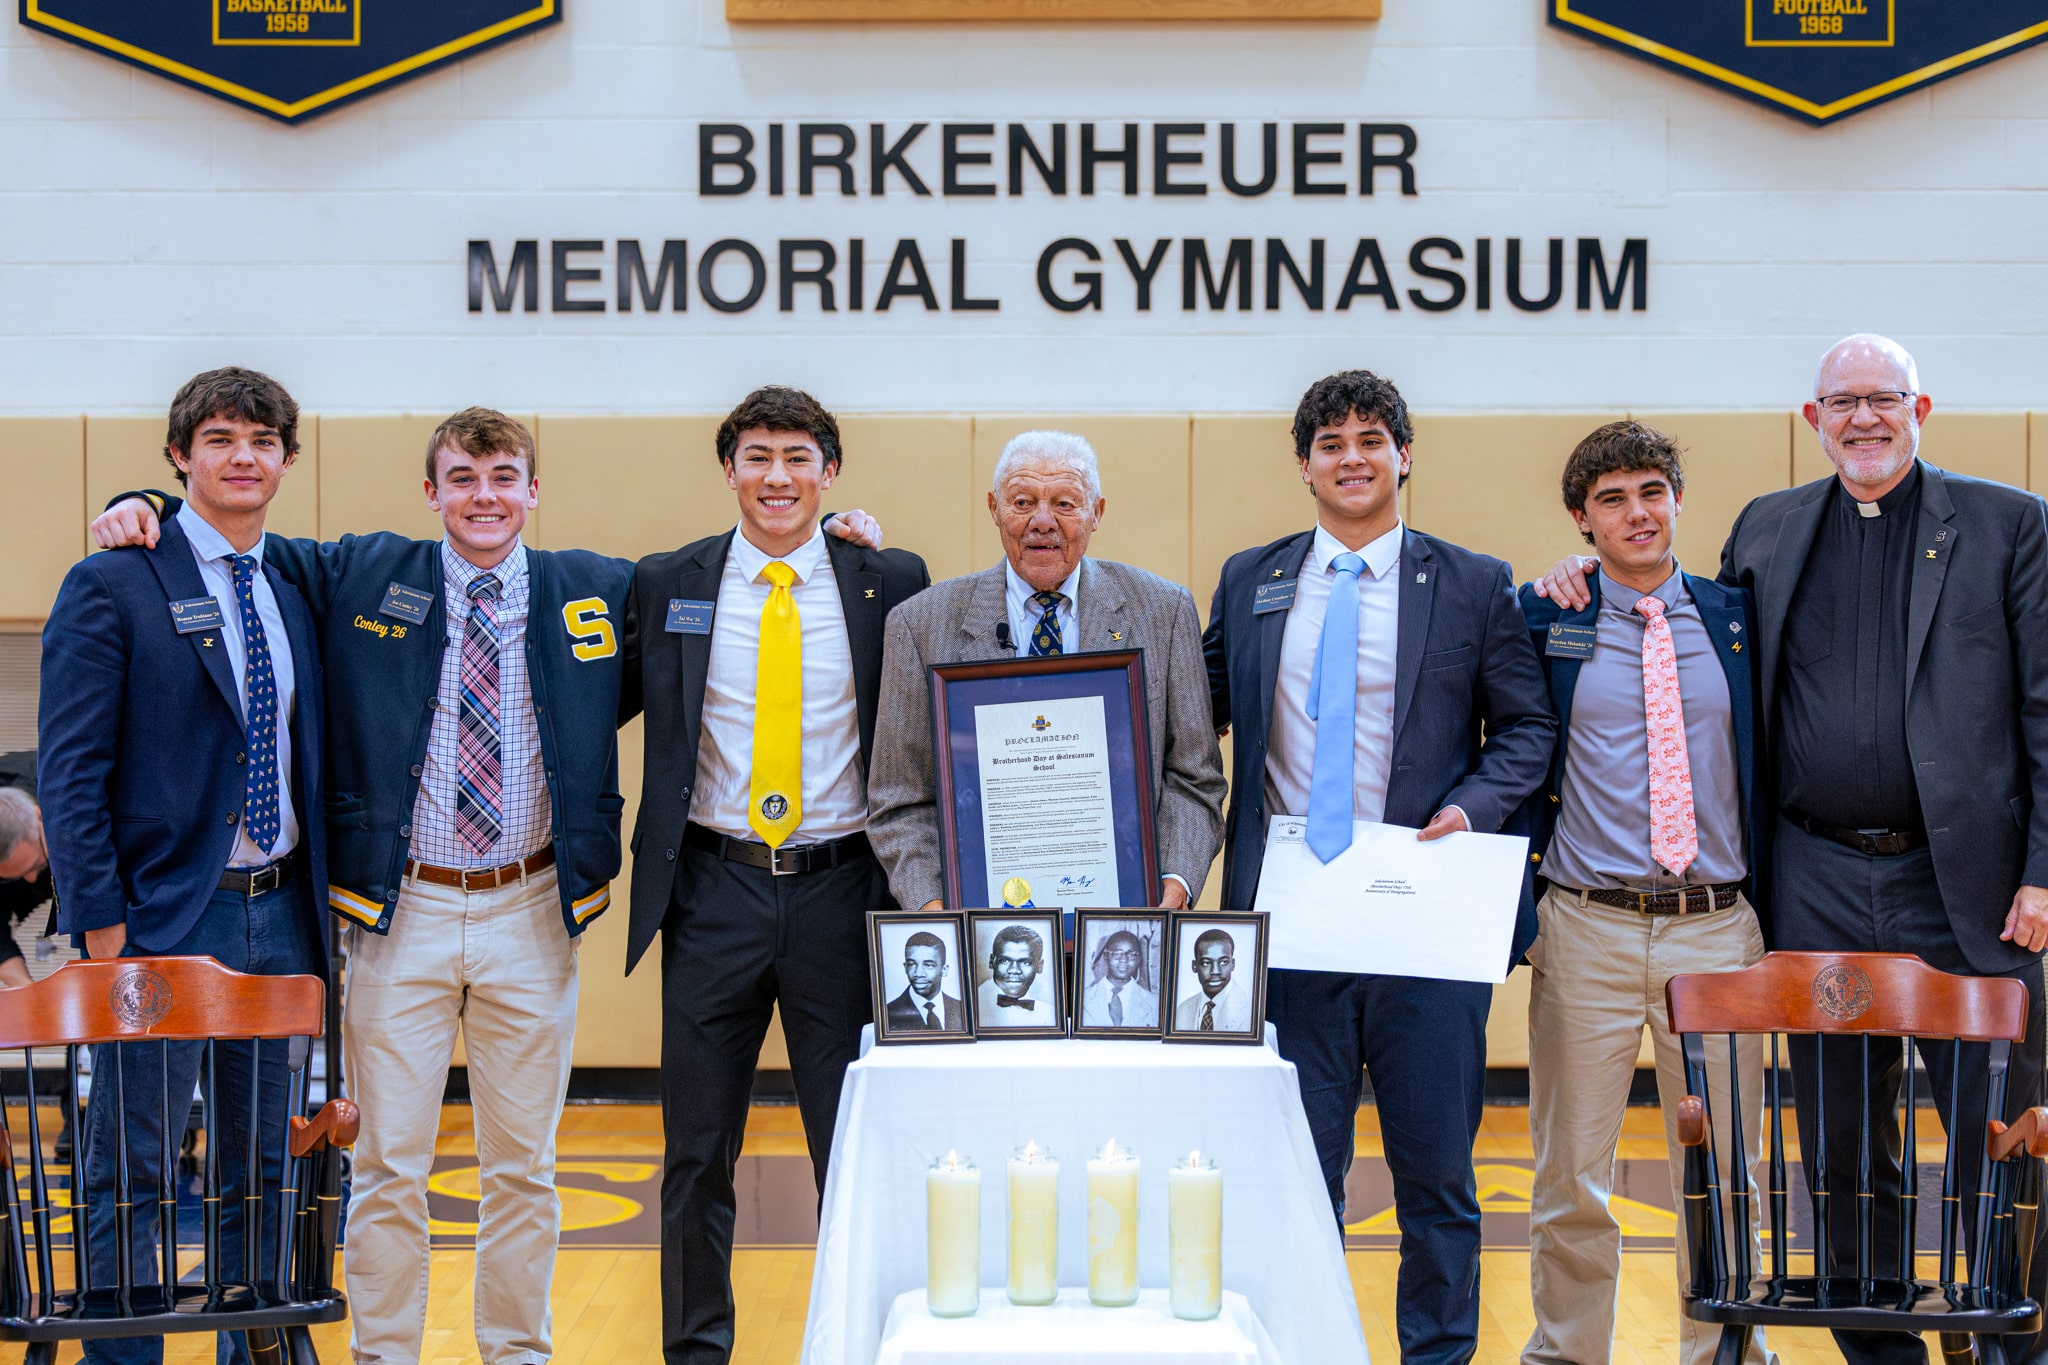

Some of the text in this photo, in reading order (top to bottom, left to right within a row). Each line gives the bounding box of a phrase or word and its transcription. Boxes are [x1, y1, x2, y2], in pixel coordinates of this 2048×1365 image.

[226, 0, 347, 13] BASKETBALL
[1772, 0, 1868, 14] FOOTBALL
[265, 14, 310, 32] 1958
[1799, 15, 1843, 34] 1968
[698, 123, 1418, 197] BIRKENHEUER
[467, 237, 1648, 313] MEMORIAL GYMNASIUM
[353, 614, 408, 639] Conley '26
[562, 596, 618, 662] S
[1004, 733, 1080, 746] PROCLAMATION
[992, 756, 1032, 765] Brotherhood
[1033, 755, 1047, 763] Day
[1056, 752, 1095, 760] Salesianum
[1033, 763, 1055, 771] School
